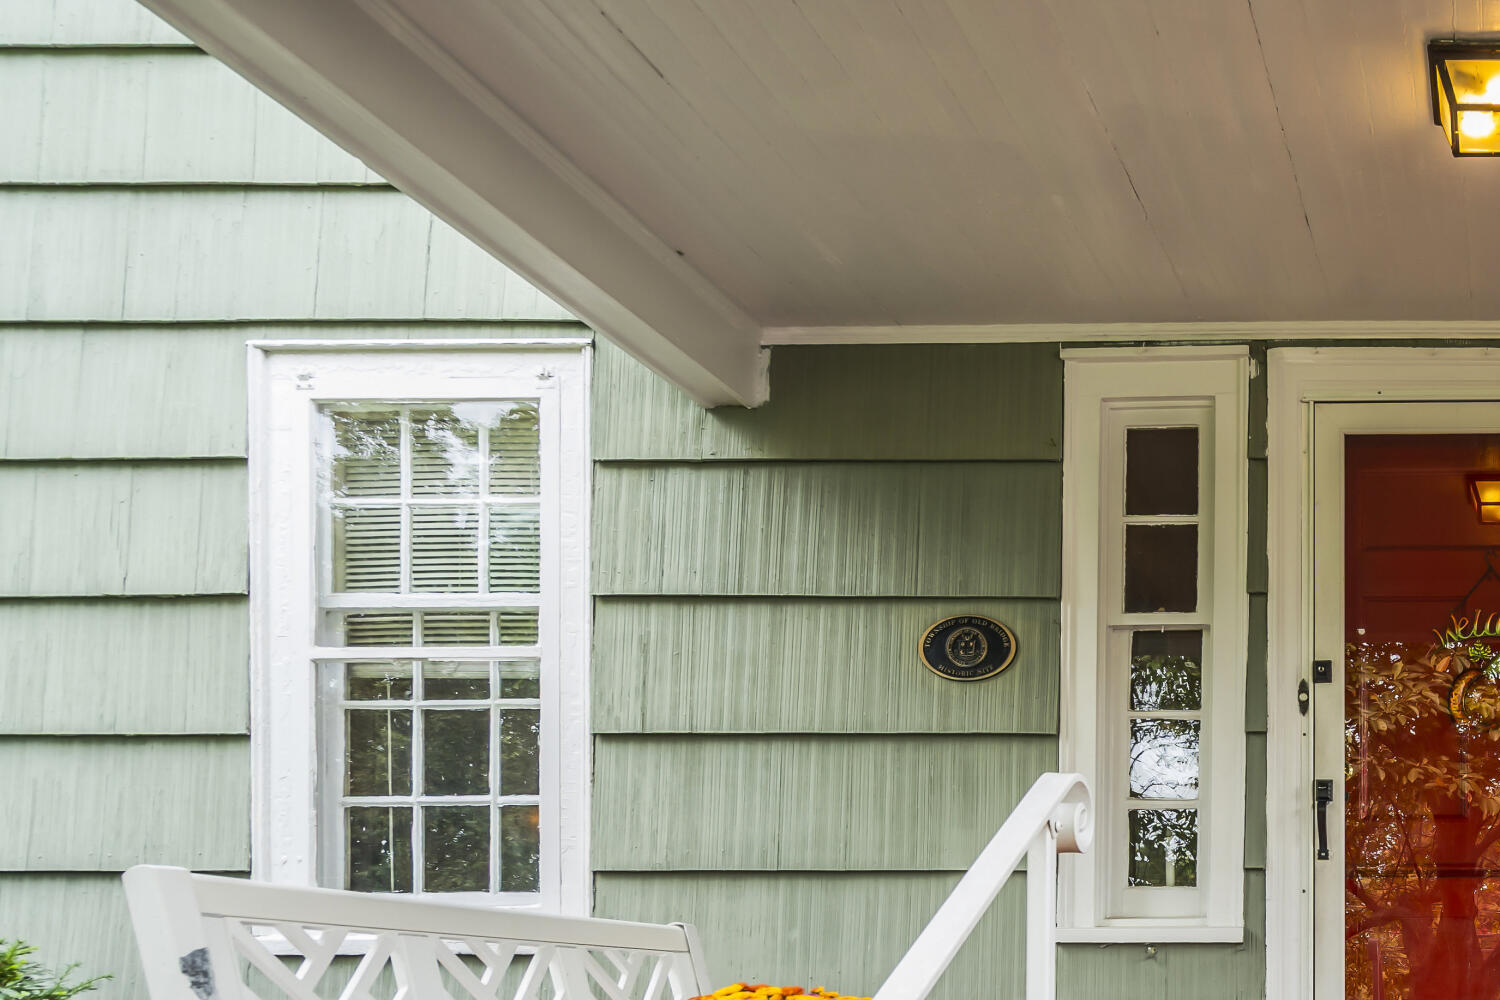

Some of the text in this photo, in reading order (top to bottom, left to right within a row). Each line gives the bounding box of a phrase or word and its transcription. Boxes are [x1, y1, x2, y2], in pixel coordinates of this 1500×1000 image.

[924, 619, 956, 648] TOWNSHIP
[990, 623, 1010, 648] BRIDGE
[938, 664, 995, 677] HISTORIC SITE
